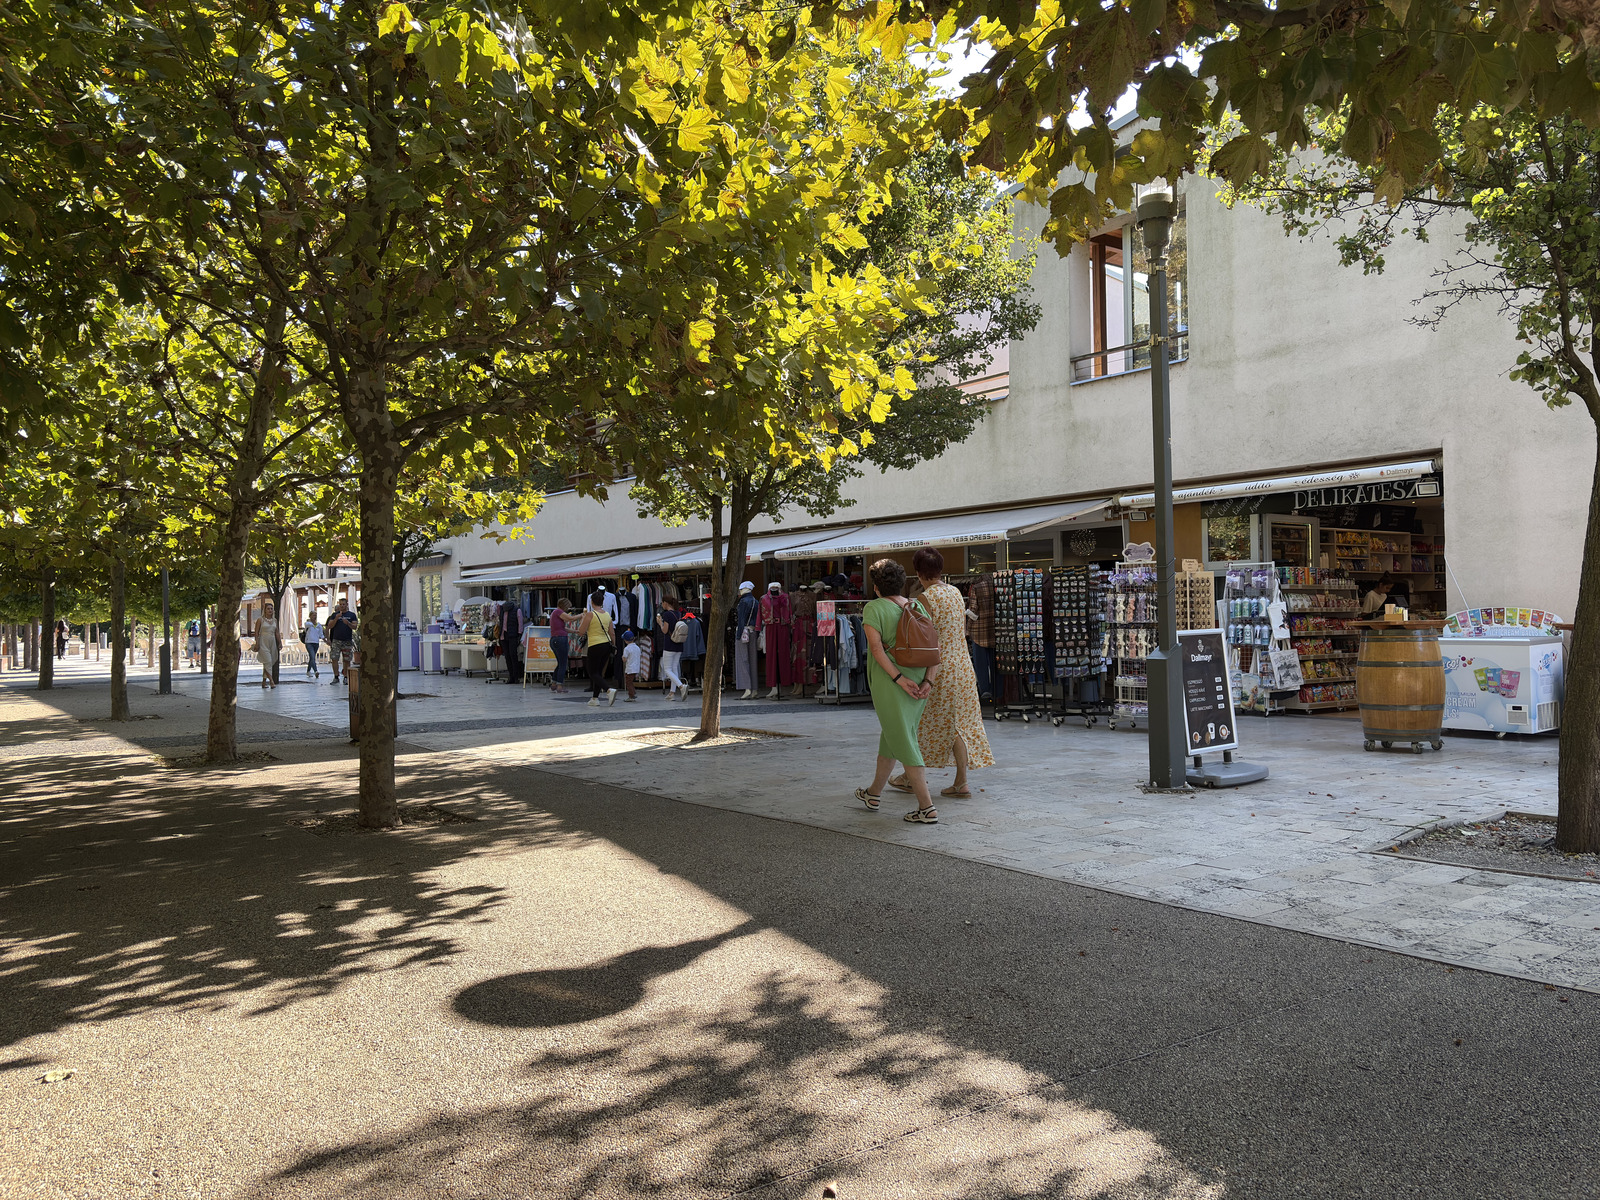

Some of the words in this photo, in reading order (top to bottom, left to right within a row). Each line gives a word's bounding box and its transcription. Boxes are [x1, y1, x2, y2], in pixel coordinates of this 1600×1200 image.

[1386, 466, 1414, 476] Dallmayr
[1301, 474, 1345, 486] édesség
[1178, 487, 1217, 500] ajándék
[817, 611, 835, 621] NEW
[1191, 653, 1213, 663] Dallmayr
[1446, 697, 1477, 709] CREAM
